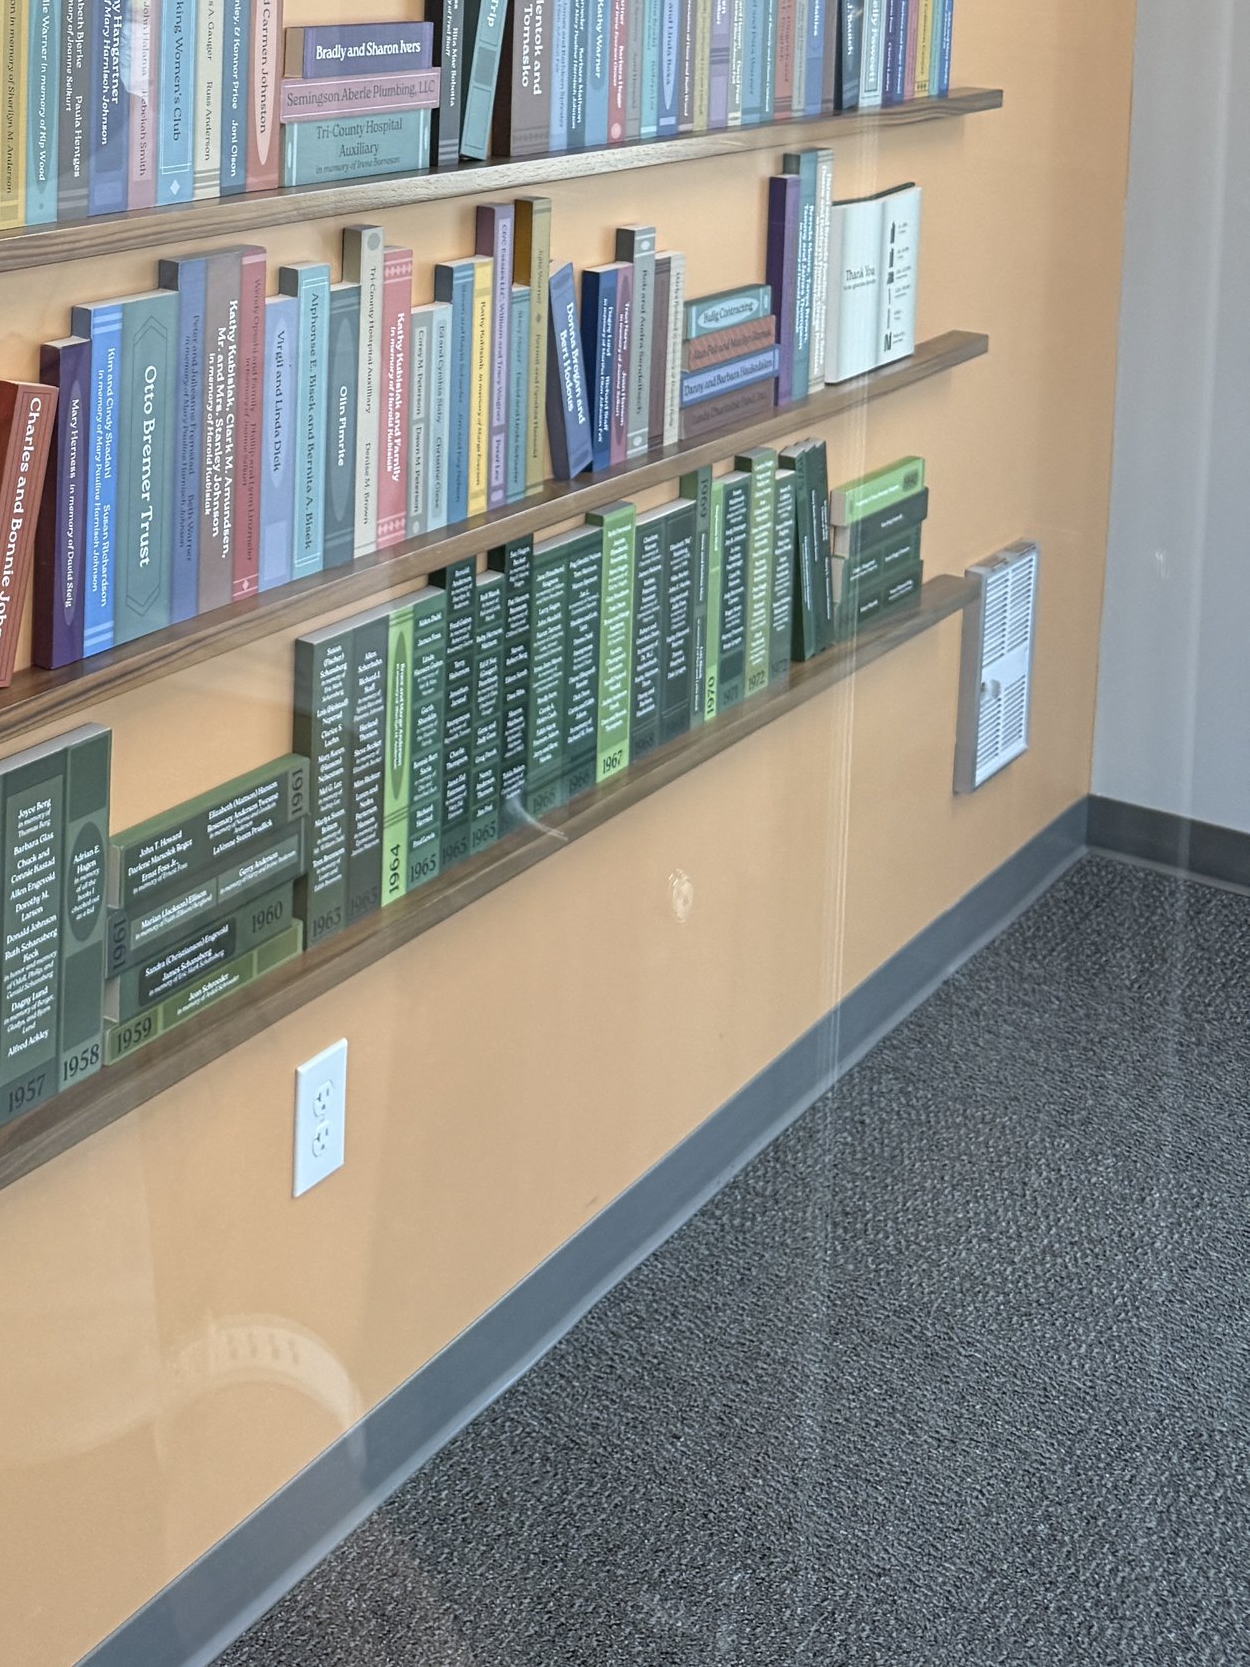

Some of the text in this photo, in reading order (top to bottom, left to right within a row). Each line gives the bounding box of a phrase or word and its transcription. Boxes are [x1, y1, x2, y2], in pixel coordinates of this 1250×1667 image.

[315, 39, 421, 61] Bradly and Sharon Ivers
[173, 36, 183, 104] Women's
[286, 78, 435, 107] Semingson Aberle Plumbing, LLC
[172, 106, 181, 141] Club
[845, 265, 875, 281] Thank You
[559, 329, 573, 412] Bert Hodous
[565, 301, 586, 424] Donna Brogan and
[19, 397, 41, 472] Charles
[138, 365, 157, 567] Otto Bremer Trust
[12, 475, 26, 513] and
[0, 518, 22, 587] Bonnie
[706, 675, 715, 714] 1970
[602, 749, 623, 774] 1967
[17, 798, 52, 819] Joyce Berg
[291, 768, 303, 814] 1961
[388, 843, 400, 893] 1964
[410, 853, 436, 882] 1965
[251, 900, 283, 933] 1960
[312, 906, 341, 937] 1963
[112, 918, 126, 970] 1961
[117, 1016, 152, 1053] 1959
[63, 1043, 99, 1081] 1958
[8, 1073, 46, 1112] 1957
